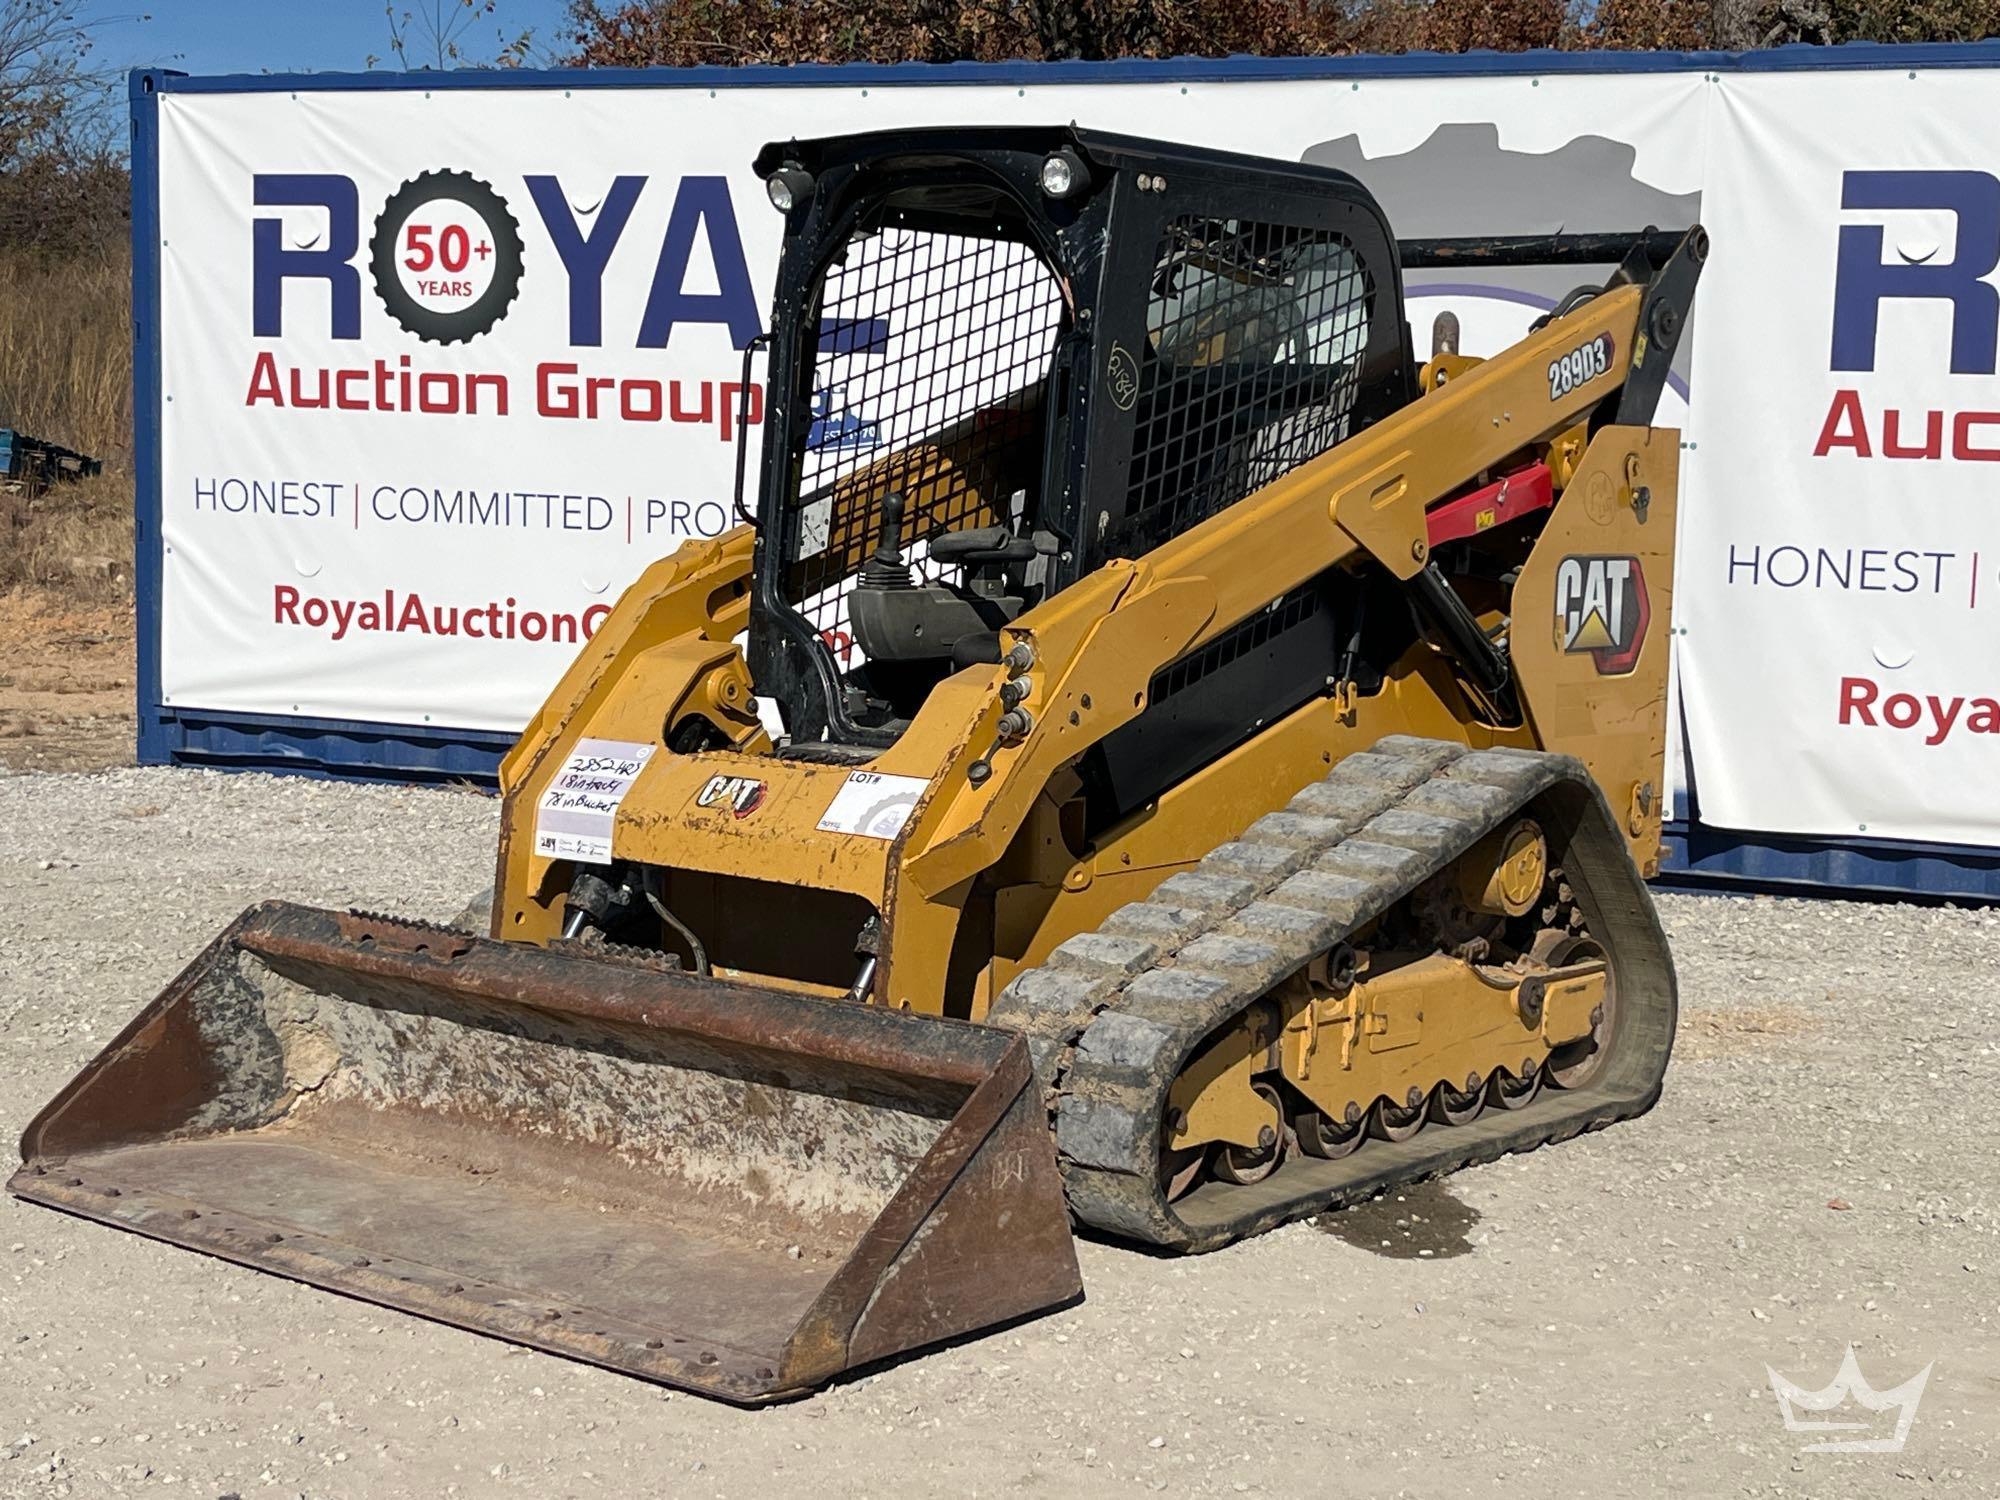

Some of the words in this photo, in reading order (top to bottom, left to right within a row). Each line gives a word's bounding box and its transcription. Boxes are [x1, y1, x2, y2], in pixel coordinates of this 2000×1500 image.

[404, 224, 492, 273] 50+
[417, 281, 472, 297] YEARS
[1549, 337, 1607, 401] 289D3
[247, 352, 508, 415] Auction
[536, 363, 763, 441] Group
[195, 478, 344, 518] HONEST
[372, 486, 613, 532] COMMITTED
[1728, 544, 1956, 593] HONEST
[1556, 559, 1630, 650] CAT
[697, 775, 761, 811] CAT
